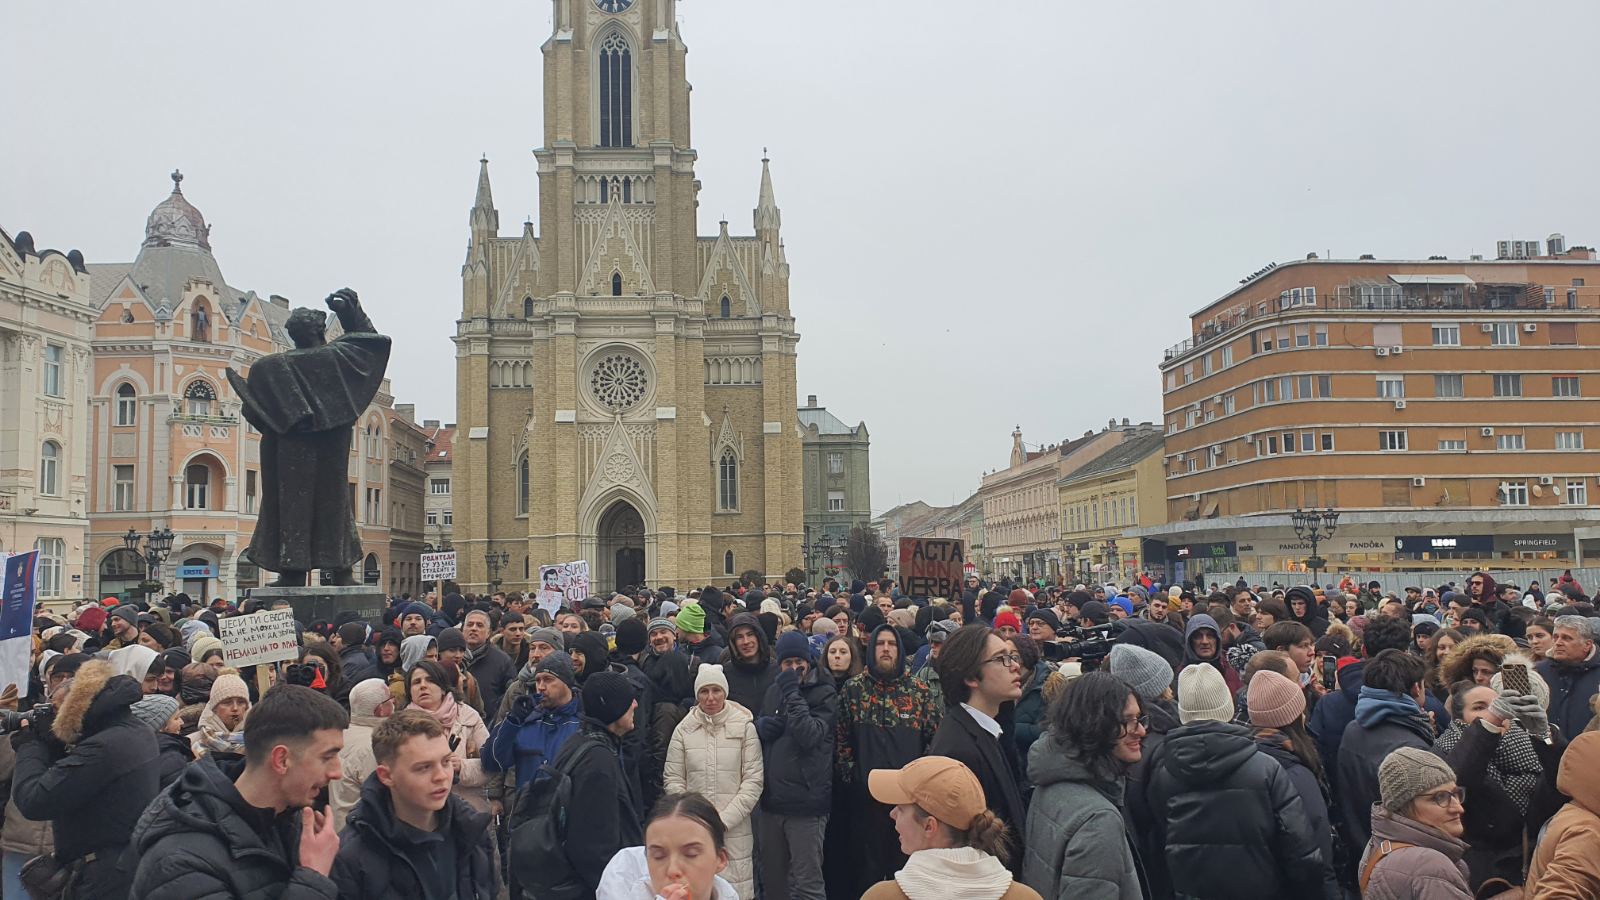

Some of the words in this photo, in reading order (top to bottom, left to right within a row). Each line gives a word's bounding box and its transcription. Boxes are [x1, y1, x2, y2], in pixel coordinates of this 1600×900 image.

[1431, 538, 1457, 547] LEON
[912, 540, 964, 563] ACTA
[912, 560, 950, 577] NON
[570, 575, 582, 587] NE
[899, 576, 964, 601] VERBA
[220, 617, 247, 629] ЈЕСИ
[249, 615, 261, 625] ТИ
[221, 630, 234, 638] ДА
[236, 627, 248, 636] НЕ
[243, 632, 265, 644] МЕНЕ
[267, 631, 278, 640] ДА
[226, 646, 258, 660] НЕМАШ
[259, 644, 268, 654] НА
[268, 642, 279, 651] ТО
